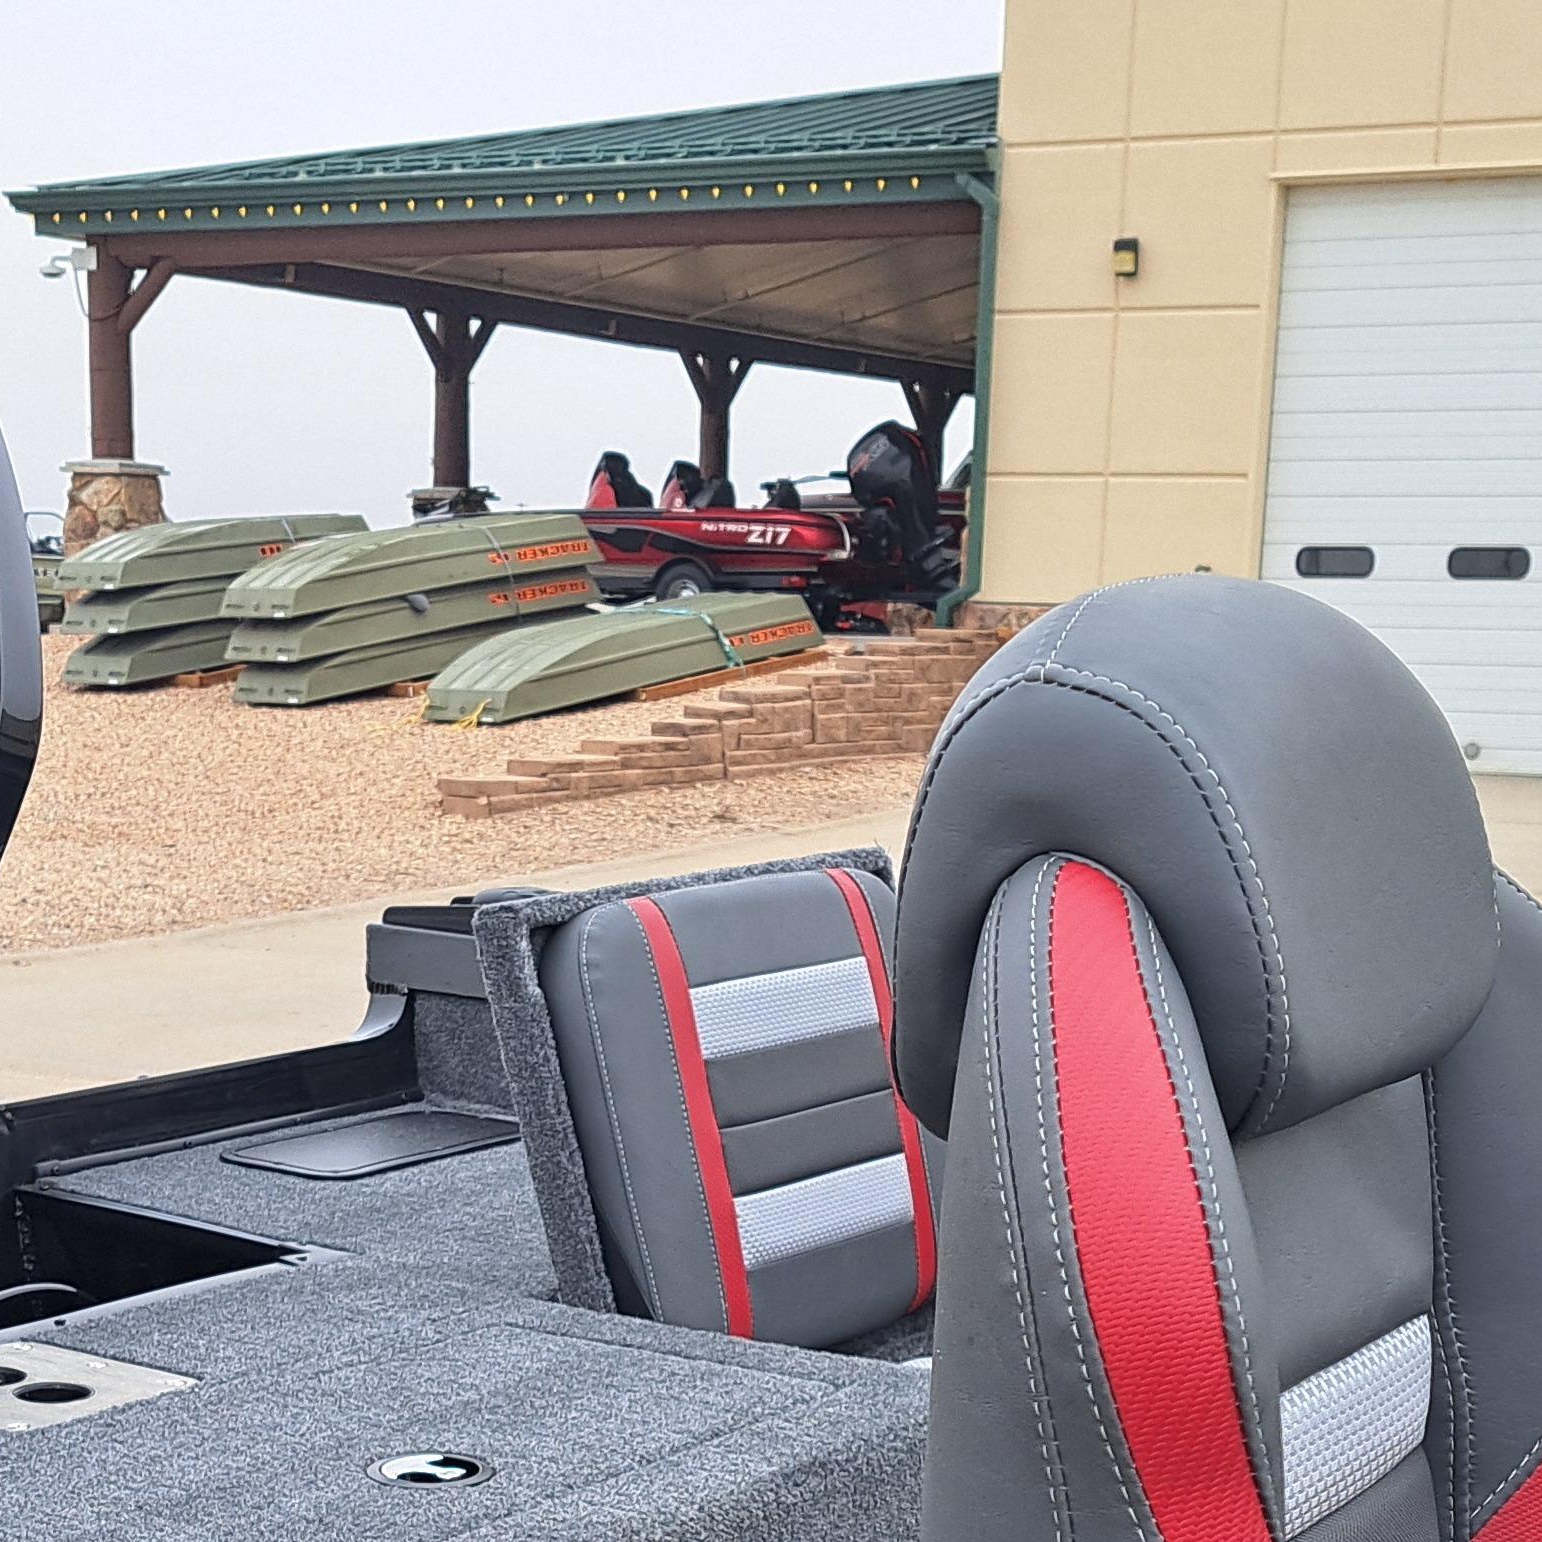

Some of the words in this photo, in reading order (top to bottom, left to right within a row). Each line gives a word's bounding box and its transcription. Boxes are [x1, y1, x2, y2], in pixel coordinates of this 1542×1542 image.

[746, 525, 791, 545] Z17
[517, 541, 591, 561] TRACKER
[516, 580, 589, 602] TRACKER
[750, 621, 814, 644] TRACKER
